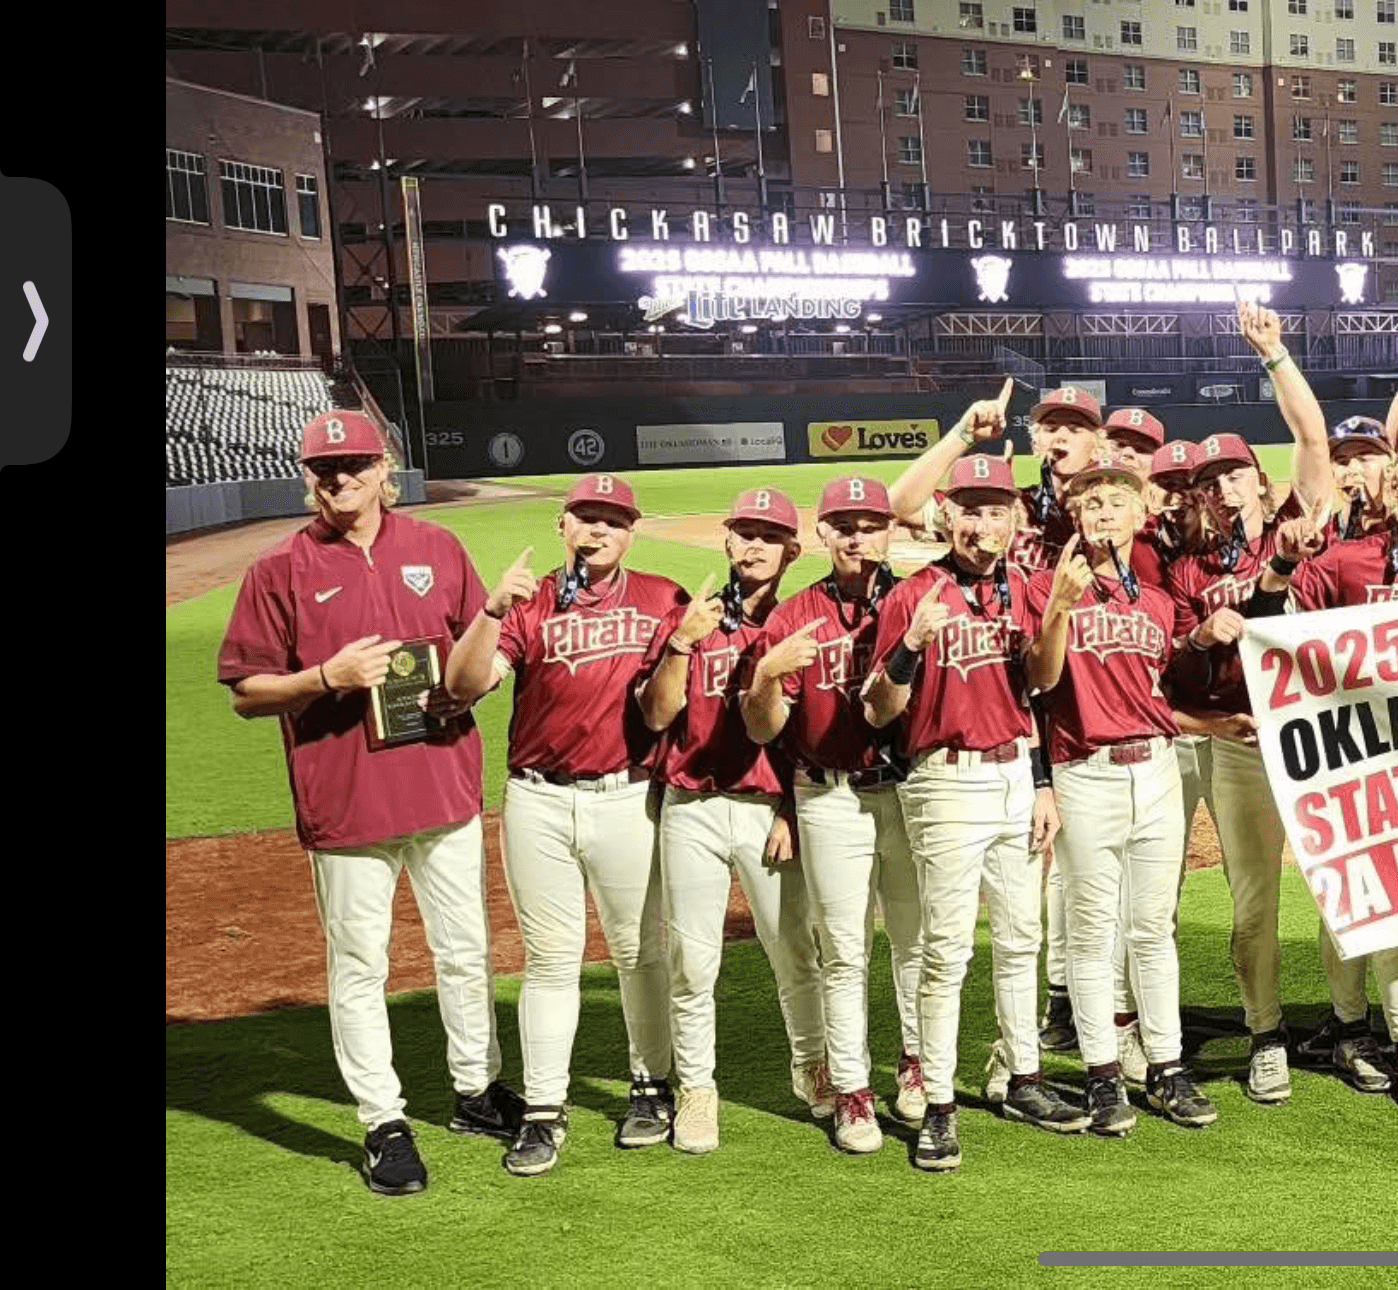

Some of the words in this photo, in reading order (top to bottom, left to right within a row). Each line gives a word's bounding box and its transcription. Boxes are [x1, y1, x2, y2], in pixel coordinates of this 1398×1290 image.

[488, 204, 835, 246] CHICKASAW
[871, 215, 1149, 253] BRICKTOWN
[1178, 226, 1375, 258] BALLPARK
[686, 290, 749, 328] Lite
[751, 297, 862, 319] LANDING
[1062, 386, 1076, 404] B
[1129, 408, 1144, 426] B
[326, 418, 346, 443] B
[426, 432, 464, 446] 325
[574, 438, 597, 456] 42
[1171, 444, 1187, 463] B
[1206, 437, 1220, 458] B
[973, 457, 990, 478] B
[595, 474, 613, 494] B
[850, 478, 865, 501] B
[755, 490, 770, 510] B
[1308, 853, 1393, 926] 2A
